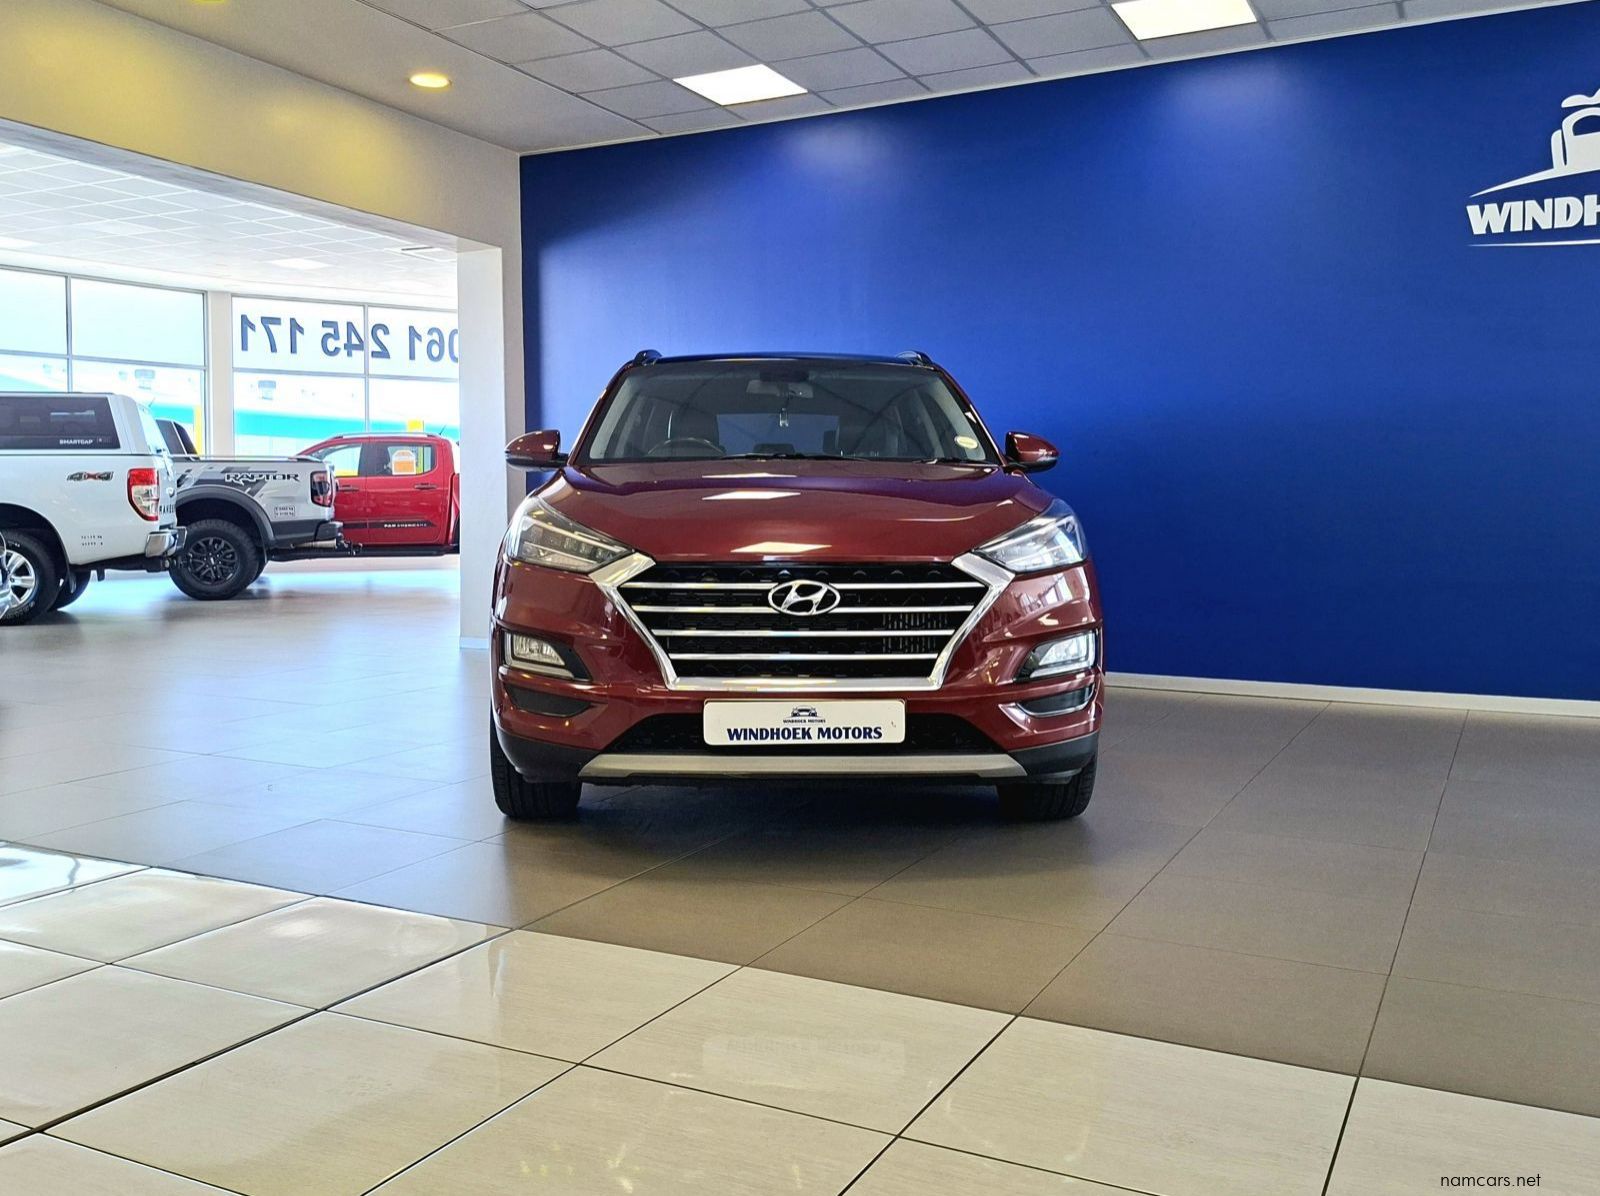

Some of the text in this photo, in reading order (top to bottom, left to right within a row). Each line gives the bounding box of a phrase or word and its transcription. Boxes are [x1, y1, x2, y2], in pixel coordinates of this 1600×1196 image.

[225, 472, 300, 485] RAPTOR
[727, 726, 882, 741] WINDHOEK MOTORS
